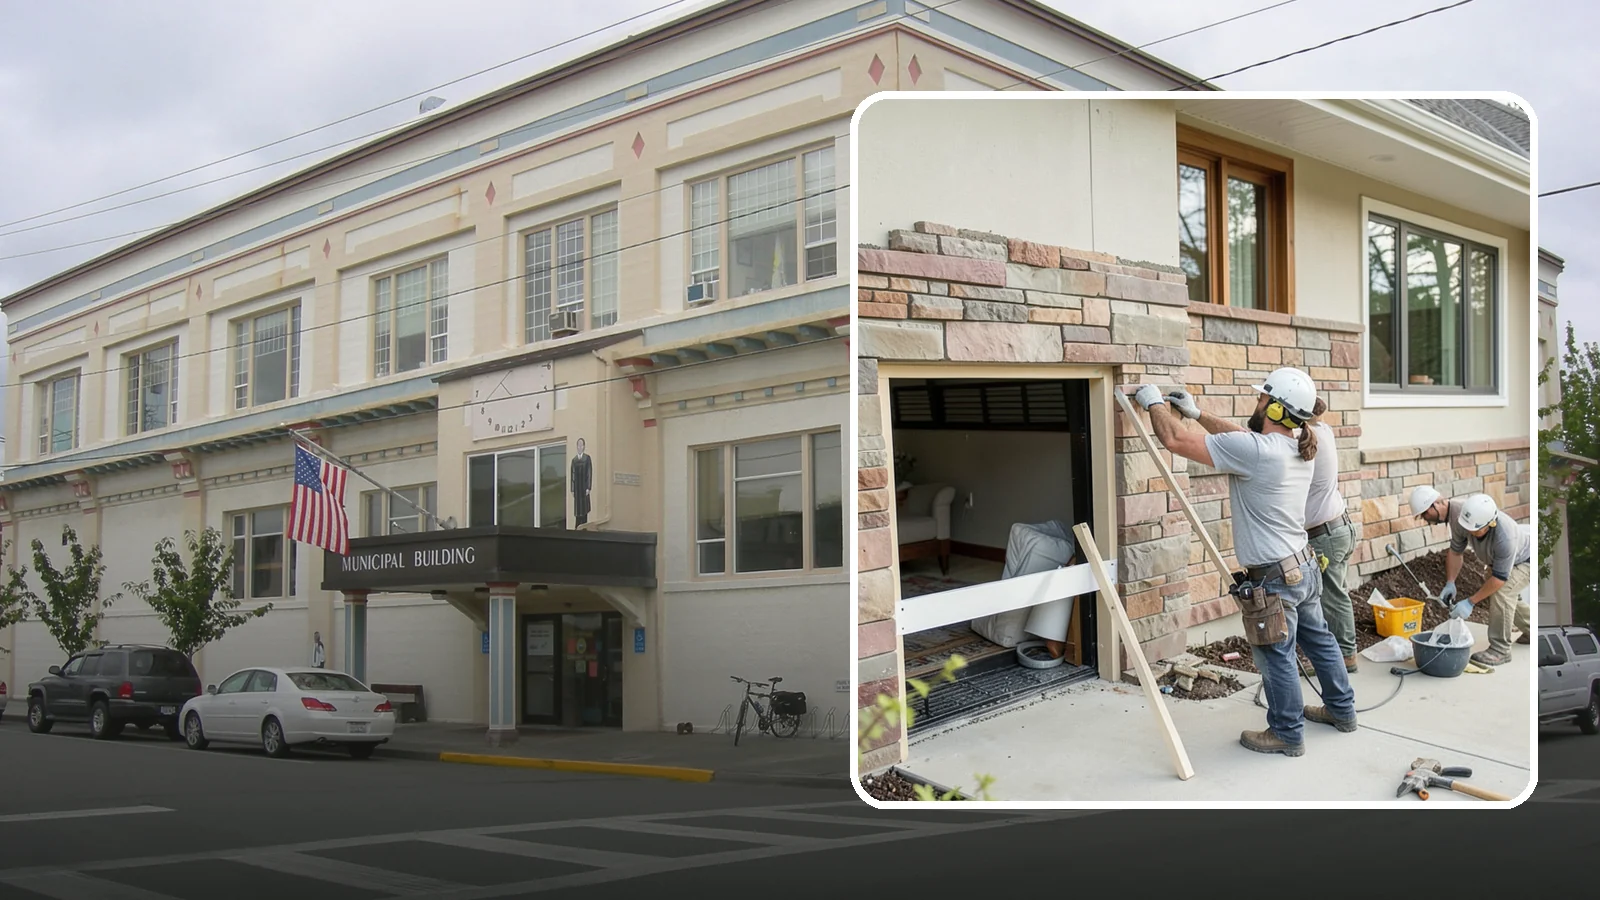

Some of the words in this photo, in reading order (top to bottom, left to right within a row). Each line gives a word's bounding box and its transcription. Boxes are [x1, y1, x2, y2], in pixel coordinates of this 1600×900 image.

[529, 414, 533, 422] 3
[342, 553, 405, 572] MUNICIPAL
[414, 546, 475, 567] BUILDING
